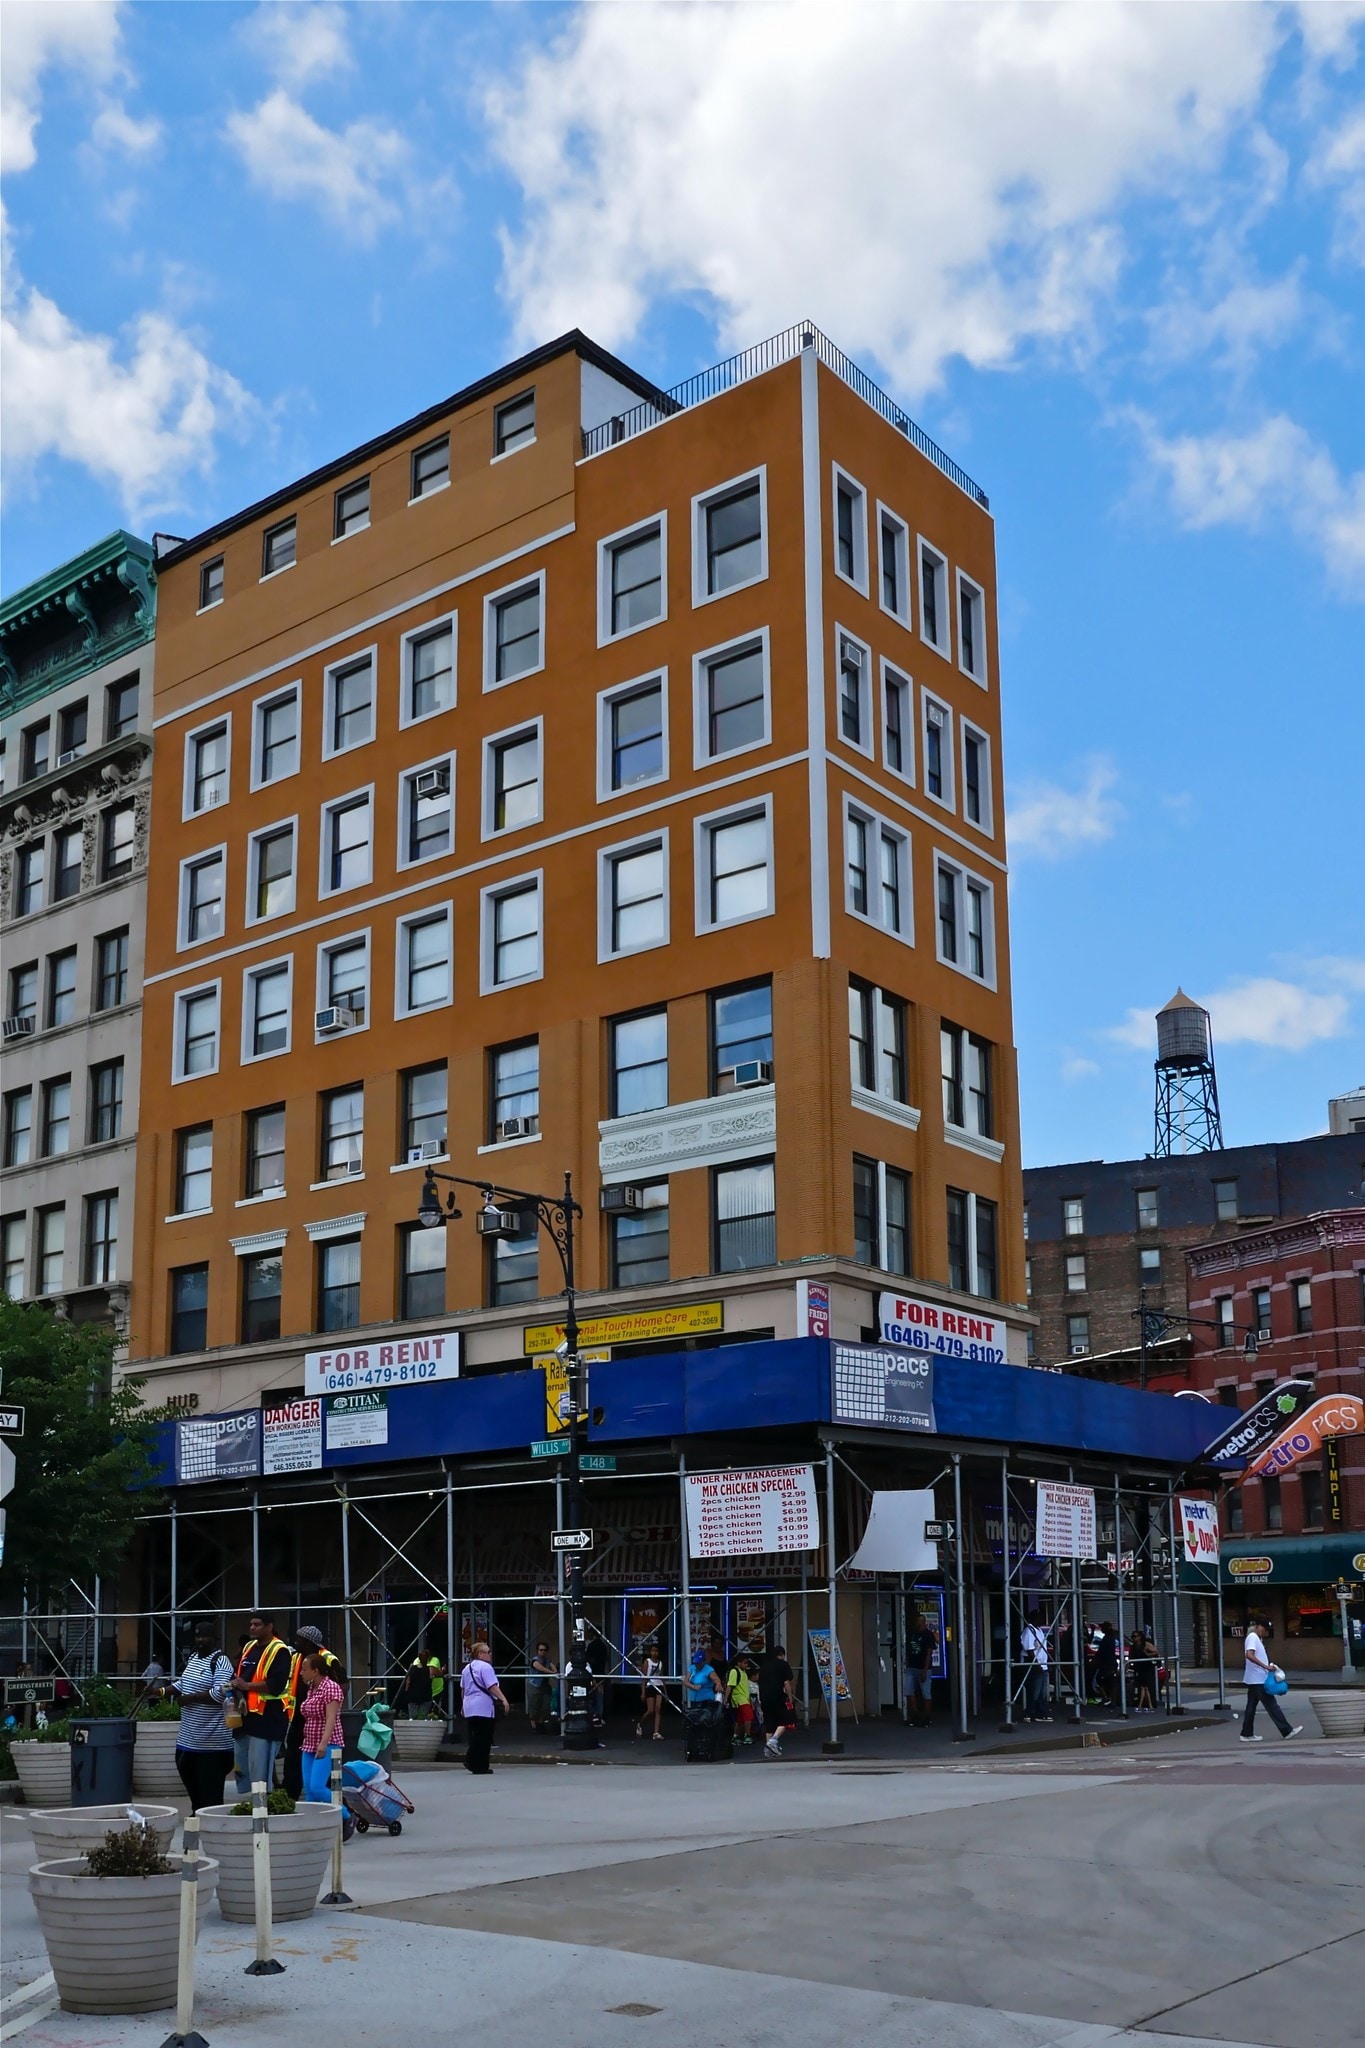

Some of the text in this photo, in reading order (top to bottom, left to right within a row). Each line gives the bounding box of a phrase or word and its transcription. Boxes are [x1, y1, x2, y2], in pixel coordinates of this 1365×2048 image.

[808, 1287, 828, 1299] KENNEDY
[634, 1317, 662, 1329] Home
[665, 1313, 688, 1324] Care
[808, 1309, 828, 1321] FRIED
[895, 1300, 995, 1342] FOR RENT
[608, 1331, 620, 1341] and
[622, 1328, 650, 1340] Training
[652, 1325, 676, 1335] Center
[883, 1323, 1004, 1364] (646)-479-8102
[319, 1338, 445, 1374] FOR RENT
[884, 1354, 929, 1377] pace
[325, 1362, 437, 1390] (646)-479-8102
[884, 1376, 924, 1389] Engineering PC
[167, 1393, 199, 1409] HUB
[348, 1393, 380, 1407] TITAN
[264, 1401, 320, 1425] DANGER
[0, 1414, 12, 1426] AY
[216, 1415, 257, 1438] pace
[276, 1422, 301, 1431] WORKING
[302, 1420, 320, 1428] ABOVE
[1312, 1406, 1358, 1434] PCS
[532, 1442, 559, 1455] WILLIS
[273, 1461, 312, 1471] 646.355.0638
[579, 1457, 585, 1468] E
[589, 1457, 605, 1468] 148
[690, 1467, 807, 1485] UNDER NEW MANAGEMENT
[702, 1478, 798, 1498] MIX CHICKEN SPECIAL
[1065, 1487, 1094, 1496] MANAGEMEN
[701, 1490, 806, 1506] 2pcs chicken $2.99
[1055, 1494, 1071, 1505] CHICKEN
[1072, 1496, 1090, 1507] SPECIAL
[701, 1506, 722, 1514] 4pcs
[725, 1504, 761, 1512] chicken
[726, 1512, 761, 1520] chicken
[698, 1524, 808, 1540] 12pcs chicken $10.99
[929, 1526, 941, 1534] ONE
[556, 1537, 569, 1545] ONE
[573, 1535, 586, 1544] WAY
[728, 1538, 763, 1546] chicken
[778, 1534, 809, 1542] $13.99
[728, 1546, 764, 1554] chicken
[607, 1573, 650, 1583] WINGS
[654, 1569, 728, 1582] SANWICH
[733, 1568, 762, 1578] BBQ
[766, 1566, 802, 1577] RIBS
[738, 1601, 747, 1611] 2
[8, 1682, 54, 1690] GREENSTREETS
